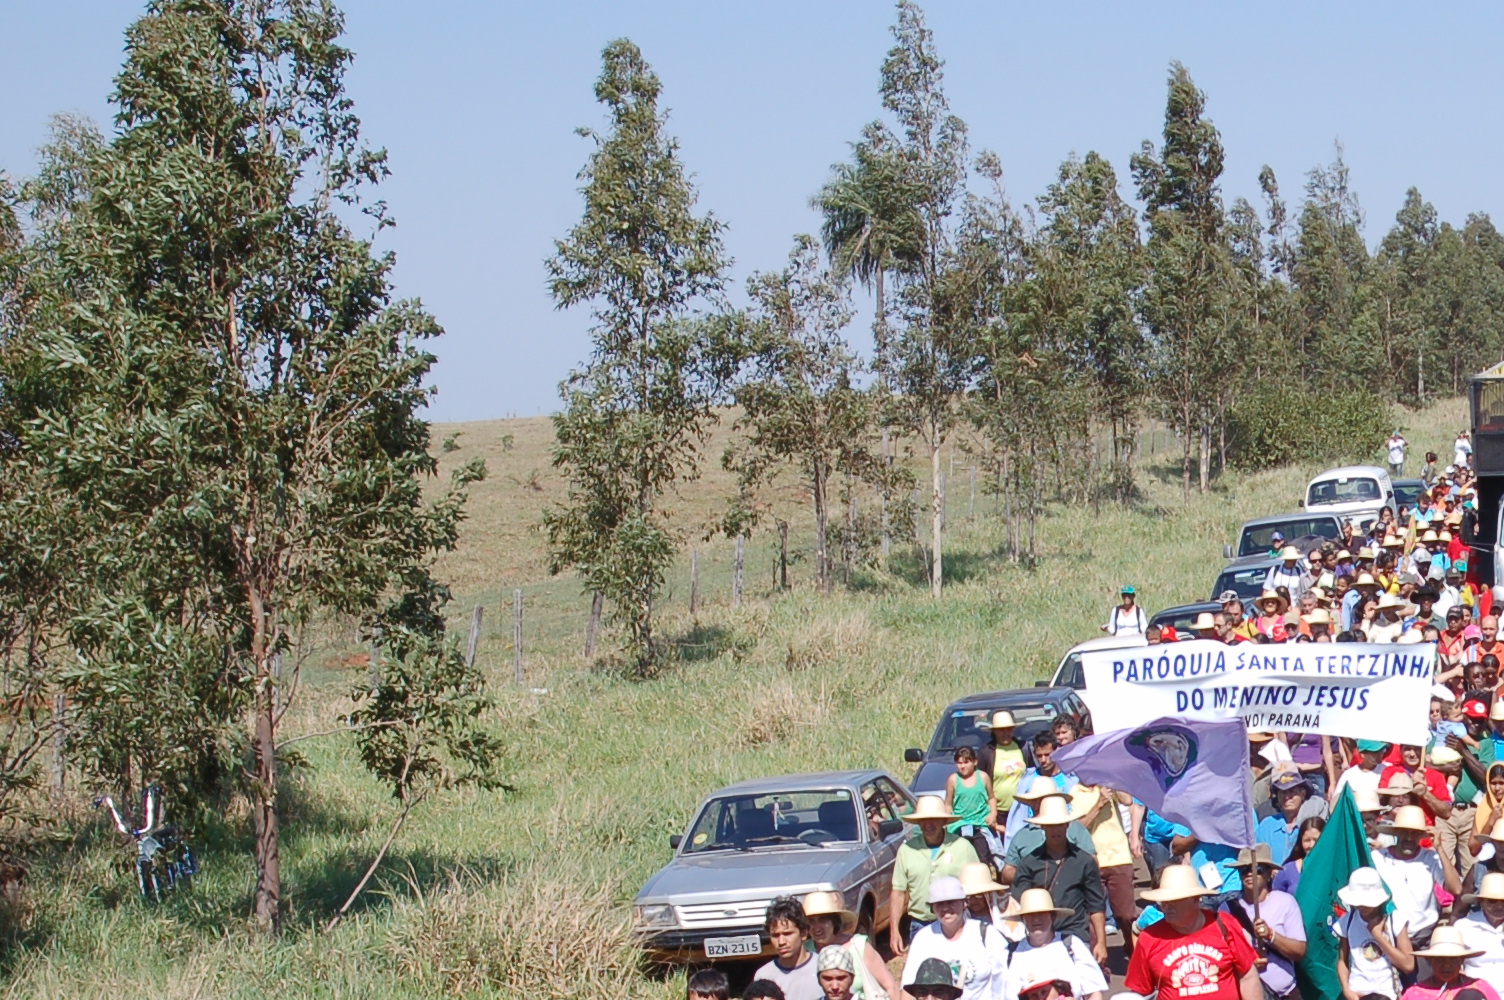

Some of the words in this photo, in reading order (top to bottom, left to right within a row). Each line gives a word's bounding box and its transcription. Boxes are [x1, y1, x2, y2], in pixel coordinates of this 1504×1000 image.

[1112, 649, 1226, 683] PARÓQUIA
[1235, 651, 1305, 672] SANTA
[1176, 687, 1204, 713] DO
[1213, 685, 1297, 709] MENINO
[1303, 684, 1370, 711] JESUS
[1267, 710, 1321, 728] PARANÁ
